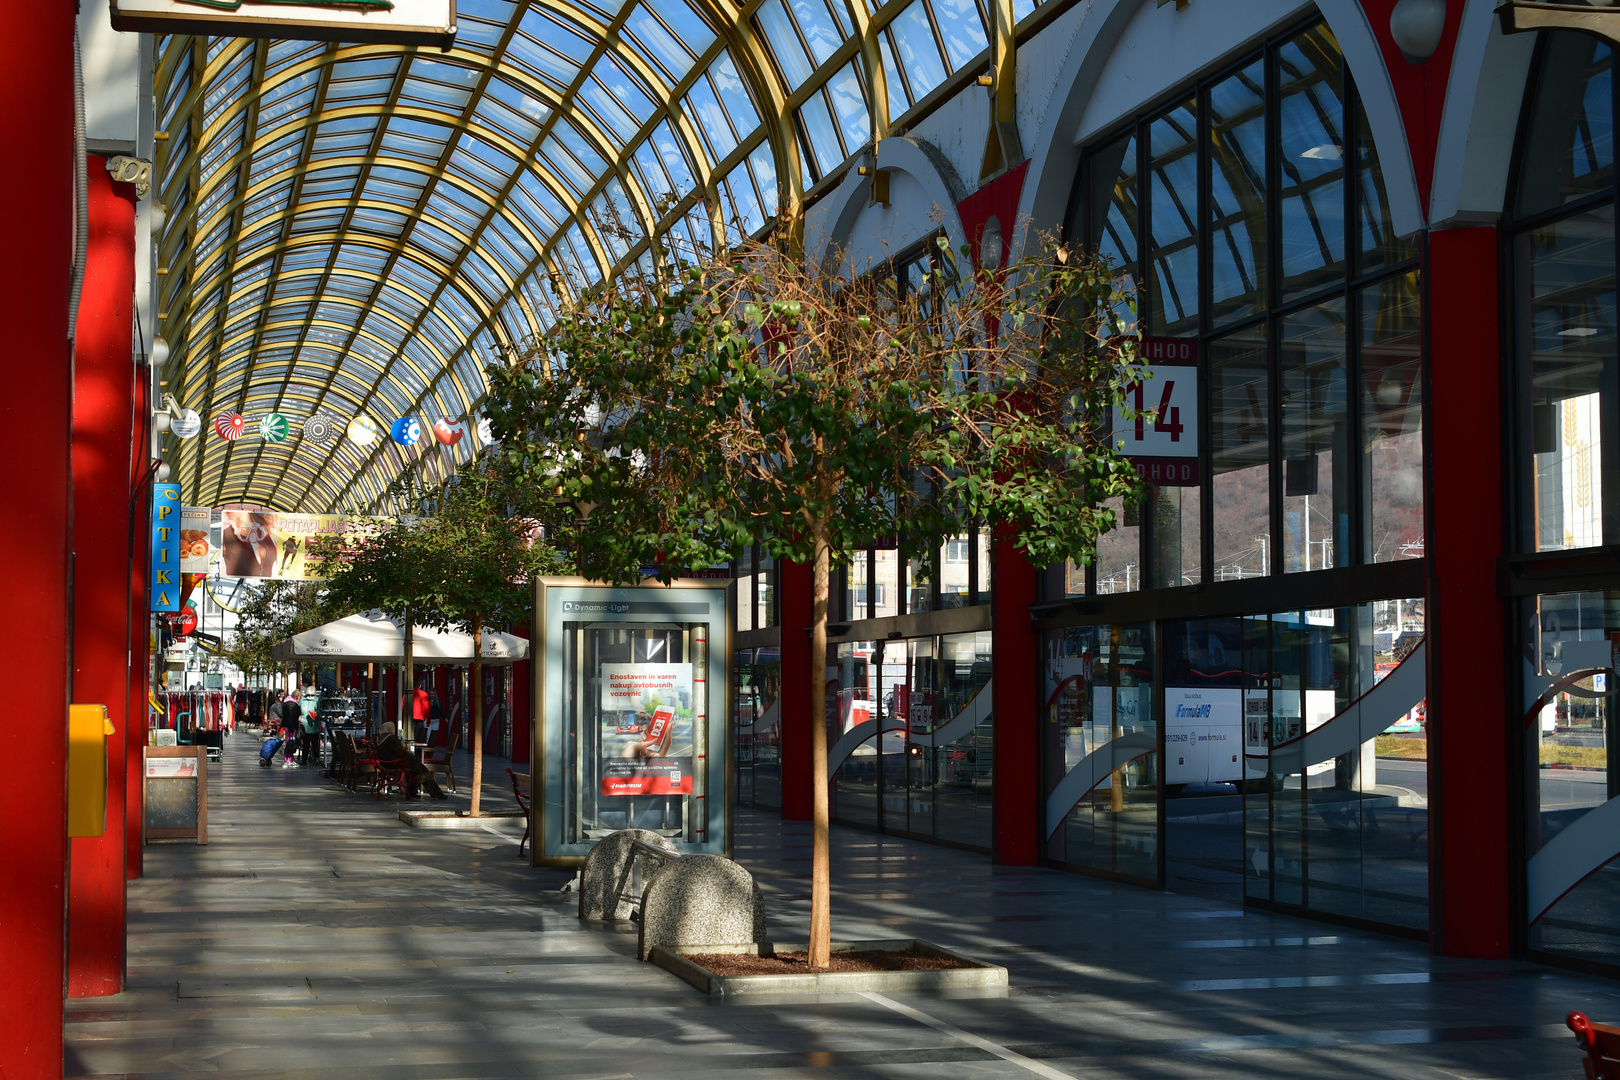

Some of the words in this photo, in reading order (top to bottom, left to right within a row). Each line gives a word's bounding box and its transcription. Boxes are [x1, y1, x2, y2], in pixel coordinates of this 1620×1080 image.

[1133, 342, 1190, 359] RIHOD
[1126, 379, 1184, 442] 14
[1136, 463, 1190, 480] DHOD
[1047, 639, 1064, 680] 14
[1249, 722, 1257, 742] 14
